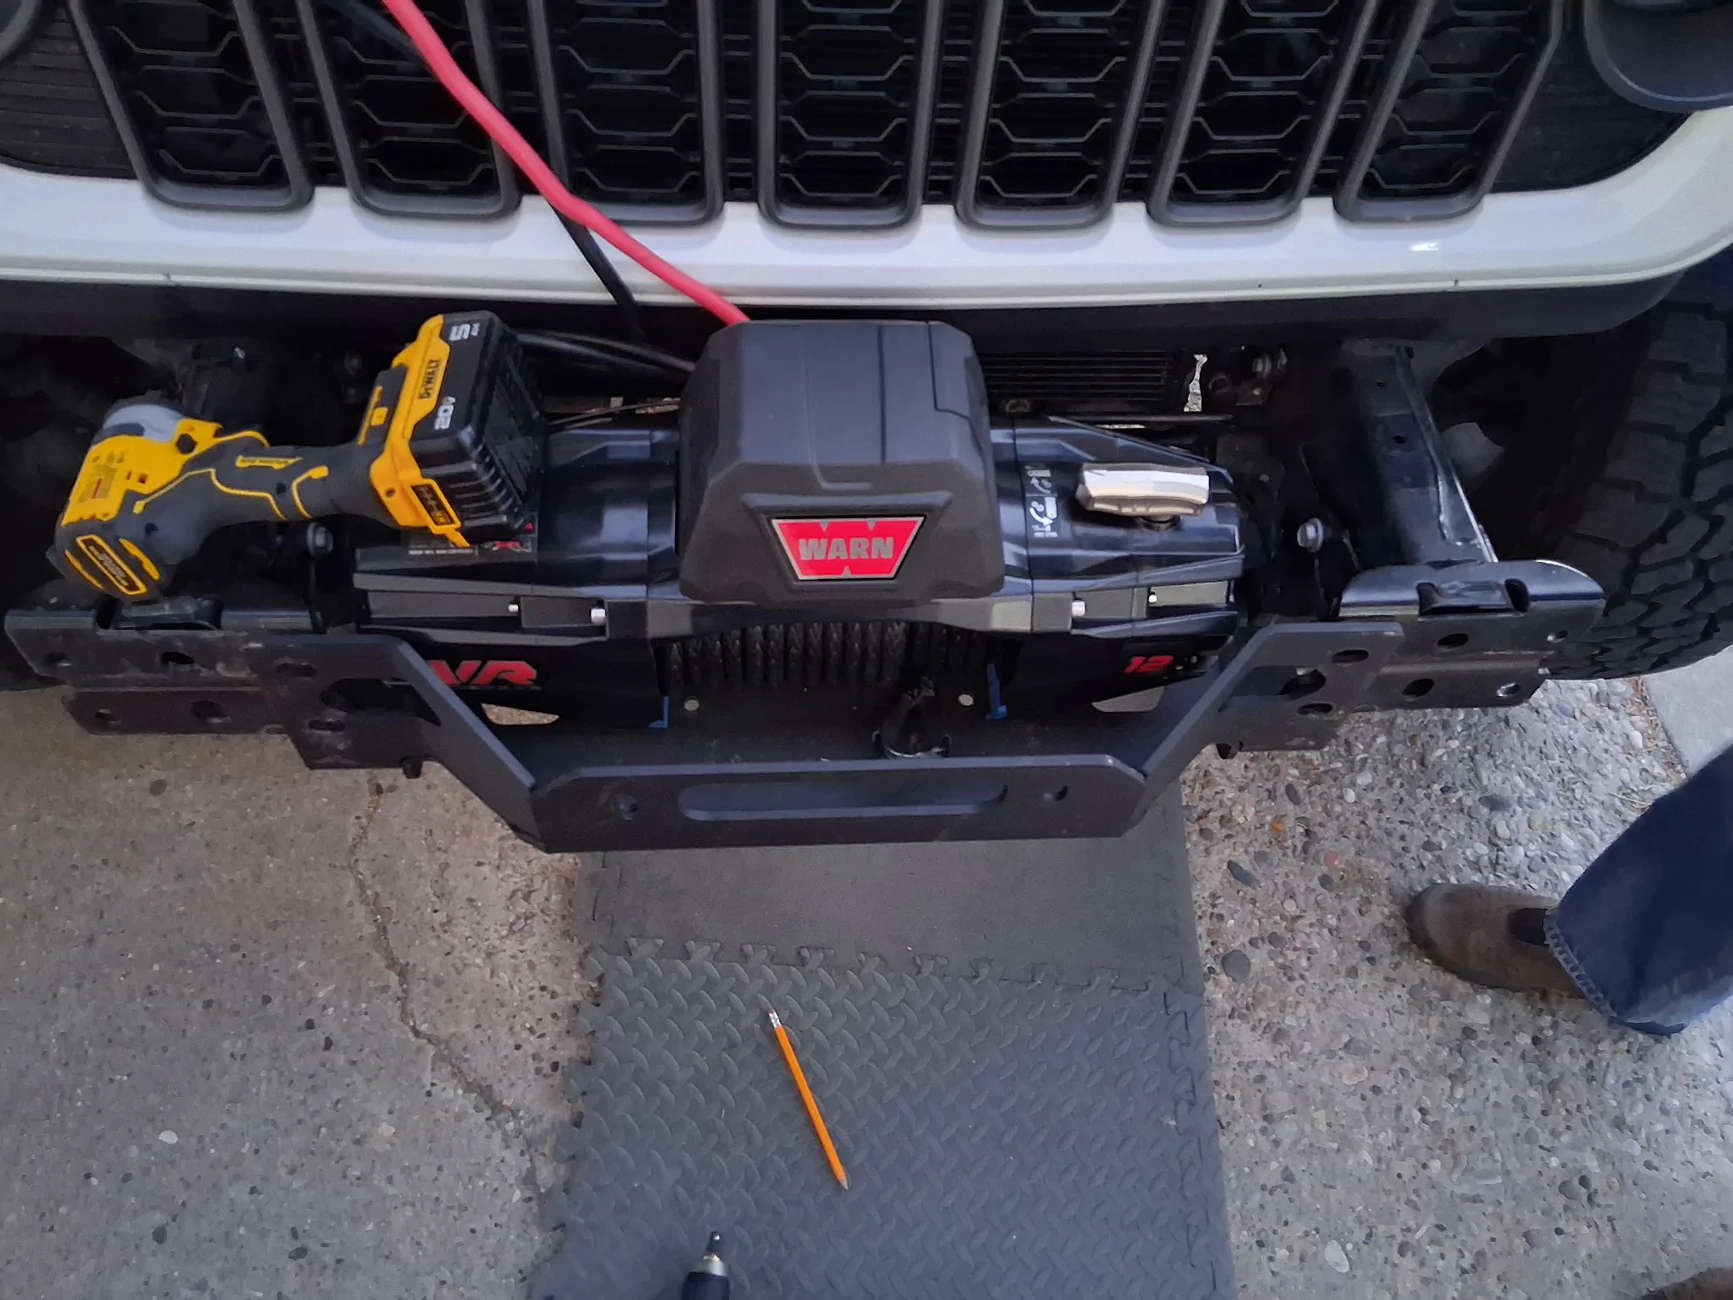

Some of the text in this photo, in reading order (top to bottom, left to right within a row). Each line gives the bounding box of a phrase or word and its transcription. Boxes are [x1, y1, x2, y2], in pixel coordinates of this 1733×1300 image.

[419, 358, 440, 400] DEWALT
[798, 537, 894, 561] WARN
[427, 659, 538, 686] VR
[1124, 655, 1174, 673] 12
